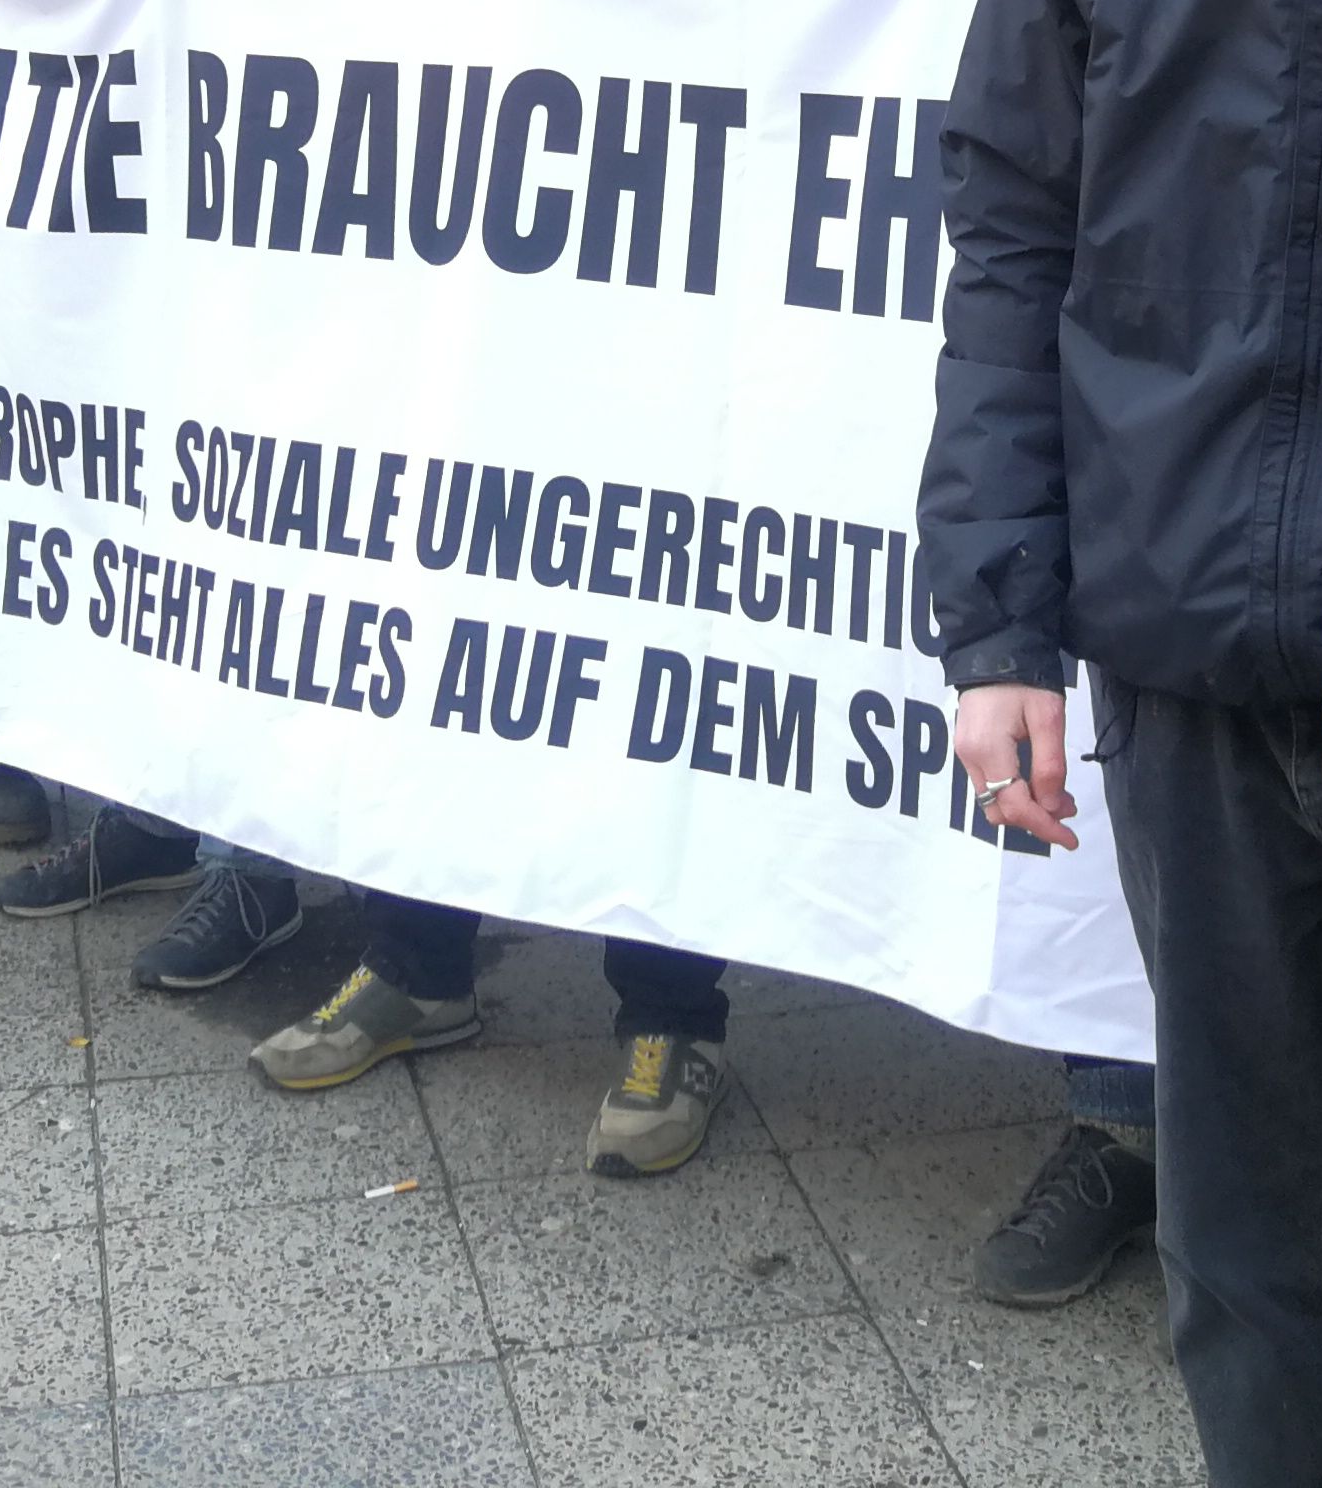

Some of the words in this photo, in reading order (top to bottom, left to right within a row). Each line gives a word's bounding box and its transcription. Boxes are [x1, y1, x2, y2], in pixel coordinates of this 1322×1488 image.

[186, 48, 748, 297] BRAUCHT
[783, 91, 951, 324] EH
[171, 419, 408, 563] SOZIALE
[1, 519, 73, 626] ES
[88, 537, 216, 673] STEHT
[218, 579, 412, 720] ALLES
[429, 616, 608, 750] AUF
[626, 646, 819, 795] DEM
[845, 689, 1052, 859] SPI
